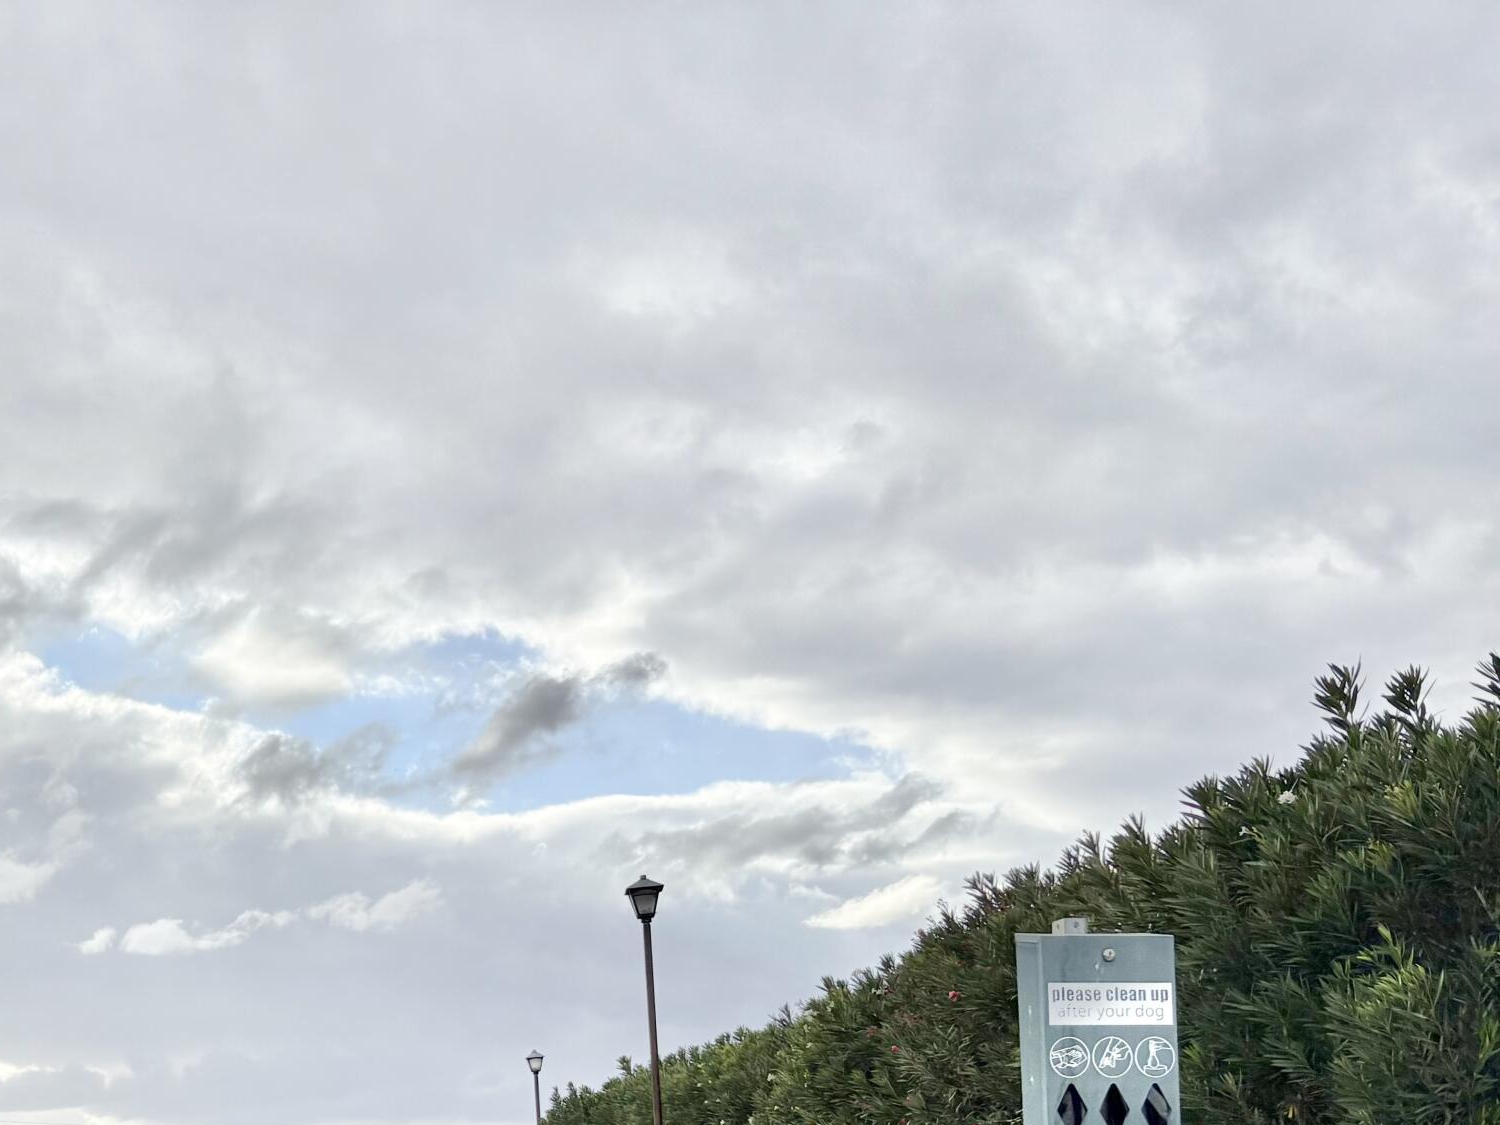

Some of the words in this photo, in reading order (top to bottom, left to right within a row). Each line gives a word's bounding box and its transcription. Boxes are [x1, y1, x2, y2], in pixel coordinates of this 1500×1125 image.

[1052, 986, 1101, 1002] please
[1106, 986, 1146, 1001] clean
[1151, 988, 1169, 1002] up
[1059, 1003, 1092, 1017] after
[1097, 1007, 1130, 1020] your
[1135, 1004, 1164, 1020] dog
